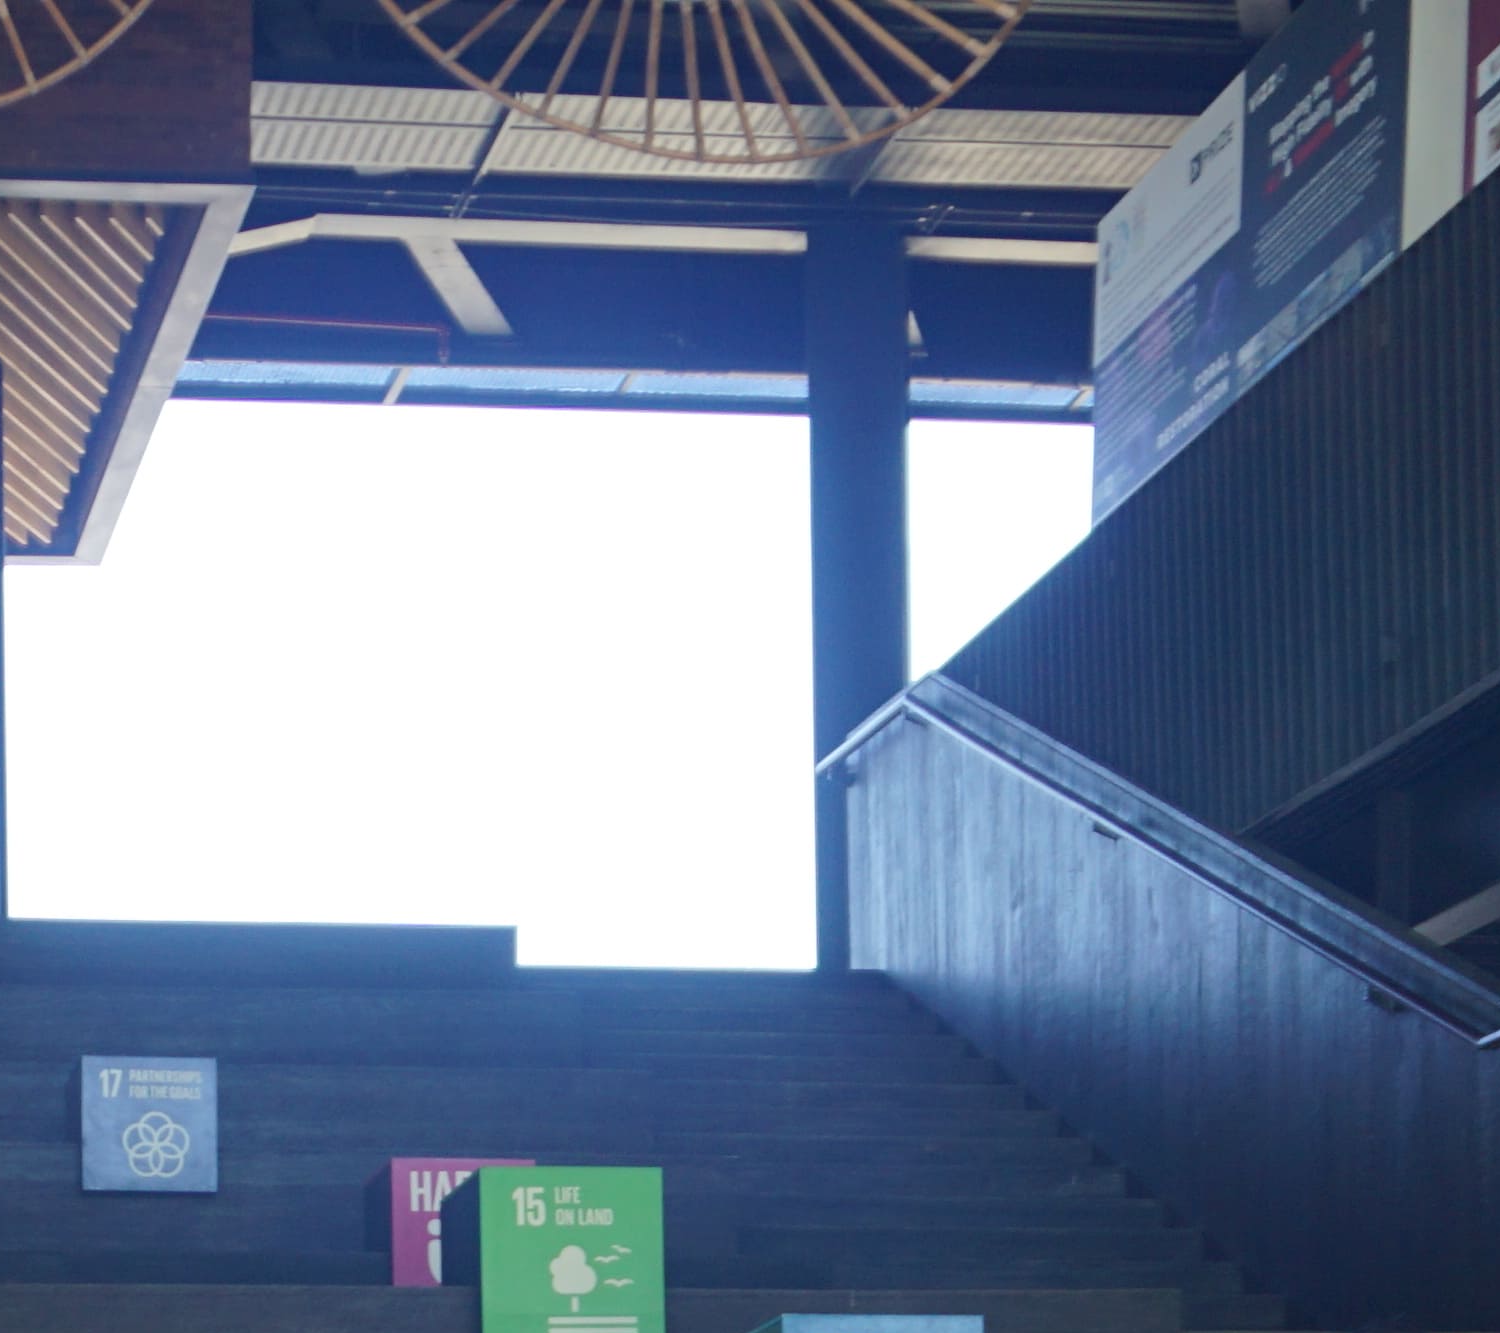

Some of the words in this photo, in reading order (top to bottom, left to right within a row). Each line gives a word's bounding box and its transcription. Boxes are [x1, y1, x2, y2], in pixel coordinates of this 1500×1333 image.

[99, 1068, 122, 1098] 17
[512, 1187, 546, 1227] 15
[554, 1186, 581, 1204] LIFE
[556, 1208, 574, 1226] ON
[578, 1208, 613, 1226] LAND
